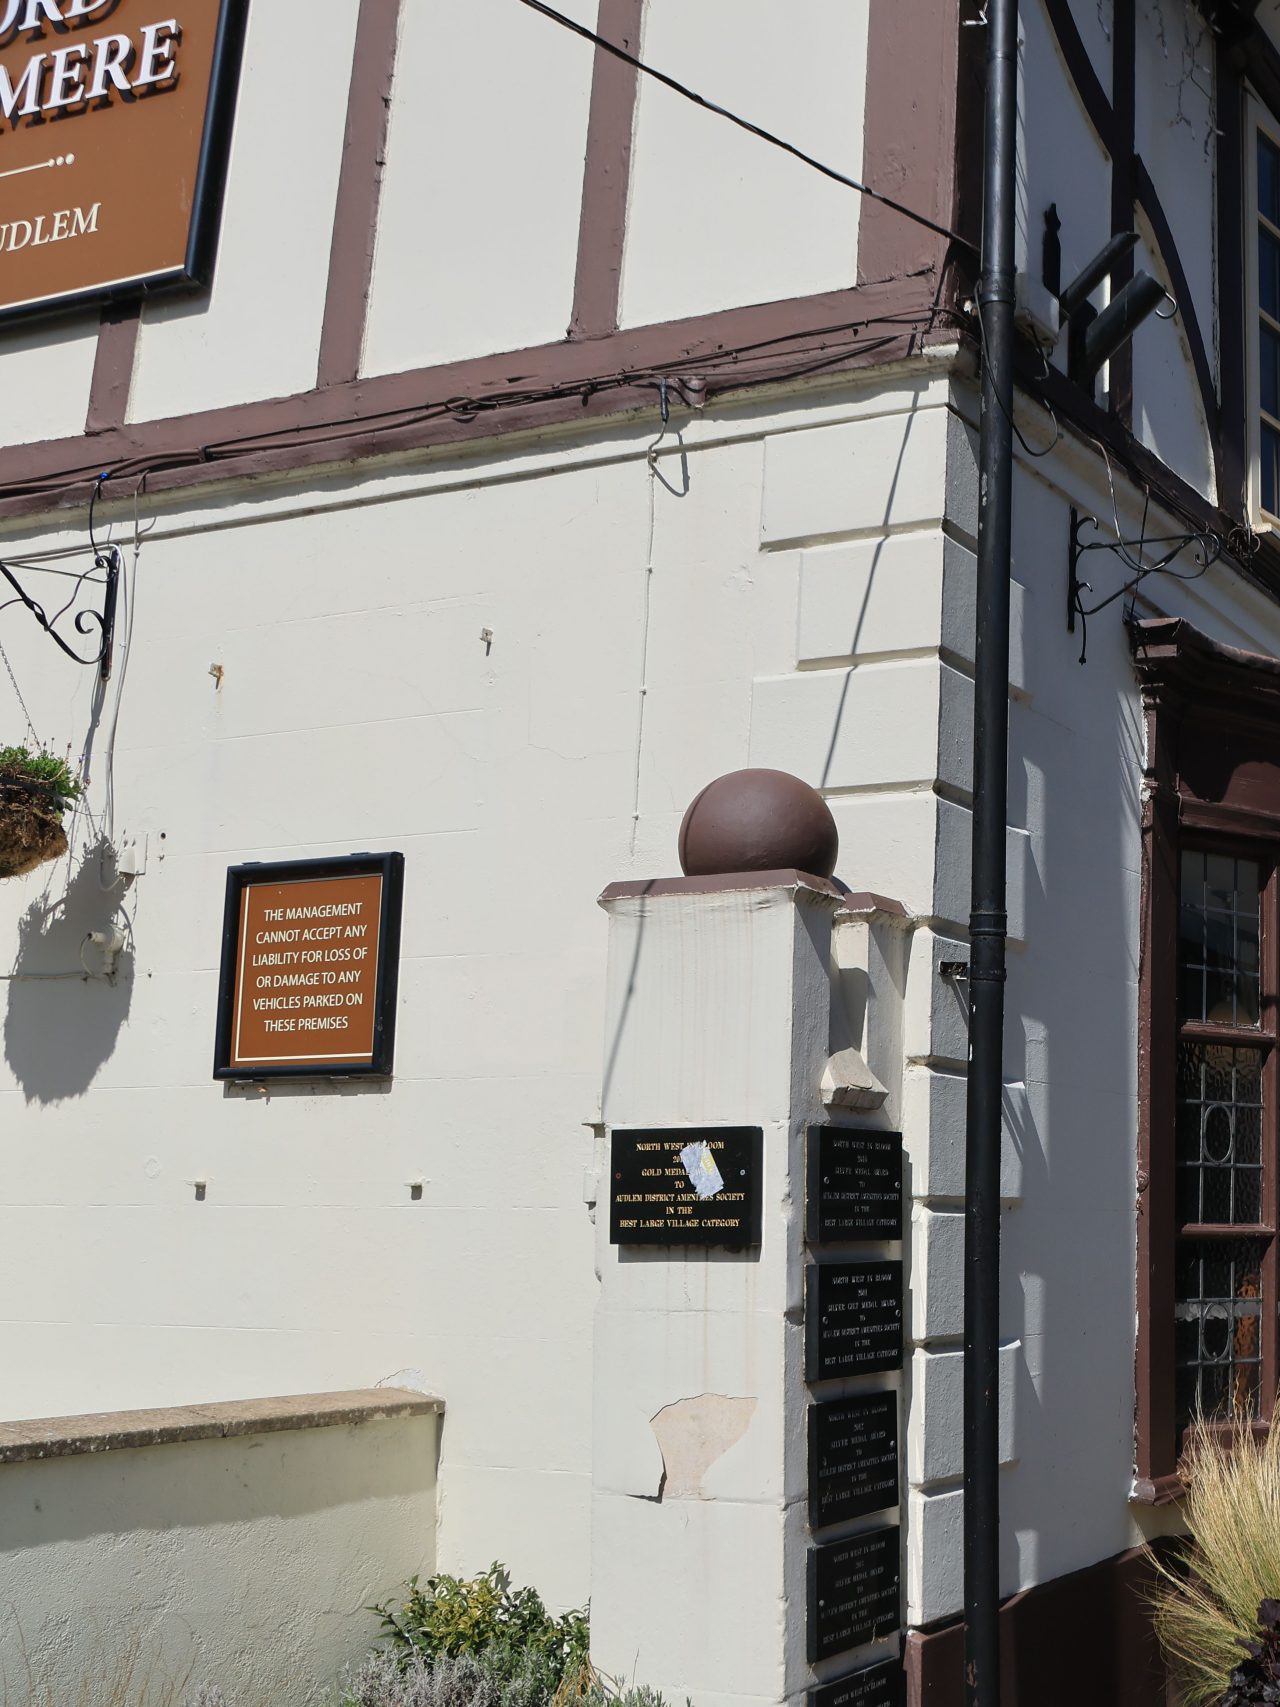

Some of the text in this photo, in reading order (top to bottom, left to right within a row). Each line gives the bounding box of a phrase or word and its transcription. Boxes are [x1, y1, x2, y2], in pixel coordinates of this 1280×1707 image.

[264, 903, 362, 921] THE MANAGEMENT
[256, 925, 367, 944] CANNOT ACCEPT ANY
[253, 947, 368, 966] LIABILITY FOR LOSS OF
[256, 970, 361, 988] OR DAMAGE TO ANY
[253, 993, 362, 1010] VEHICLES PARKED ON
[264, 1016, 348, 1031] THESE PREMISES
[636, 1142, 660, 1151] NORTH
[702, 1219, 740, 1227] CATEGORY
